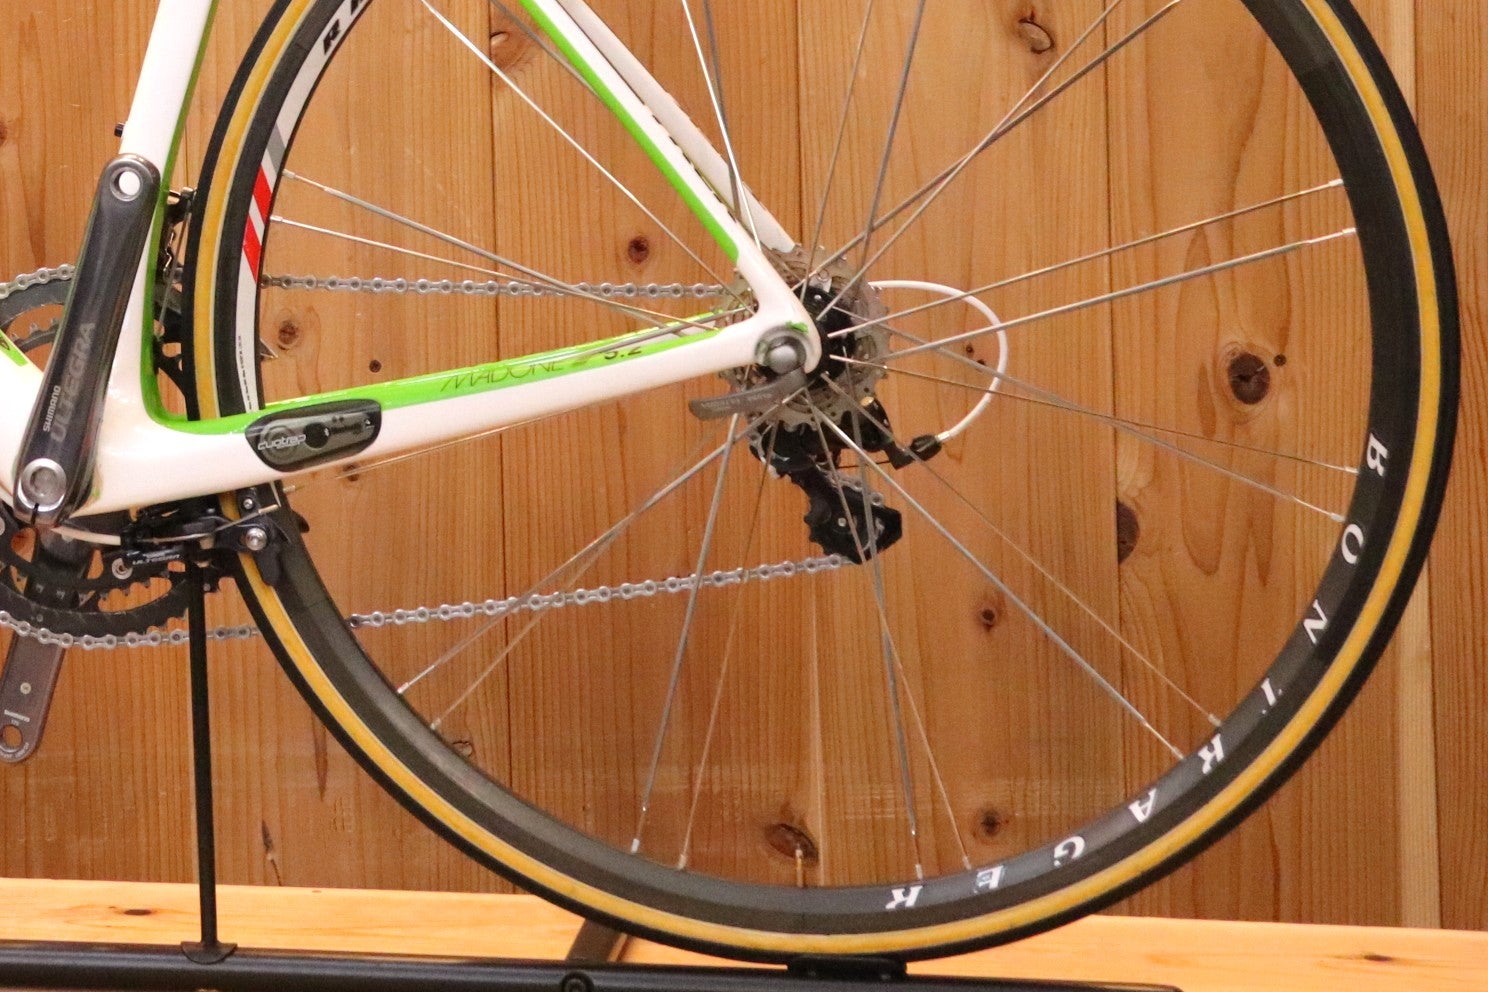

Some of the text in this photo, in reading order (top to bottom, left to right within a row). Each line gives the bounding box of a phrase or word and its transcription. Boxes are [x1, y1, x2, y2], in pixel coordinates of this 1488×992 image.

[42, 385, 61, 432] SHIMANO
[50, 323, 95, 442] ULTEGRA
[885, 432, 1390, 910] BONTRAGER
